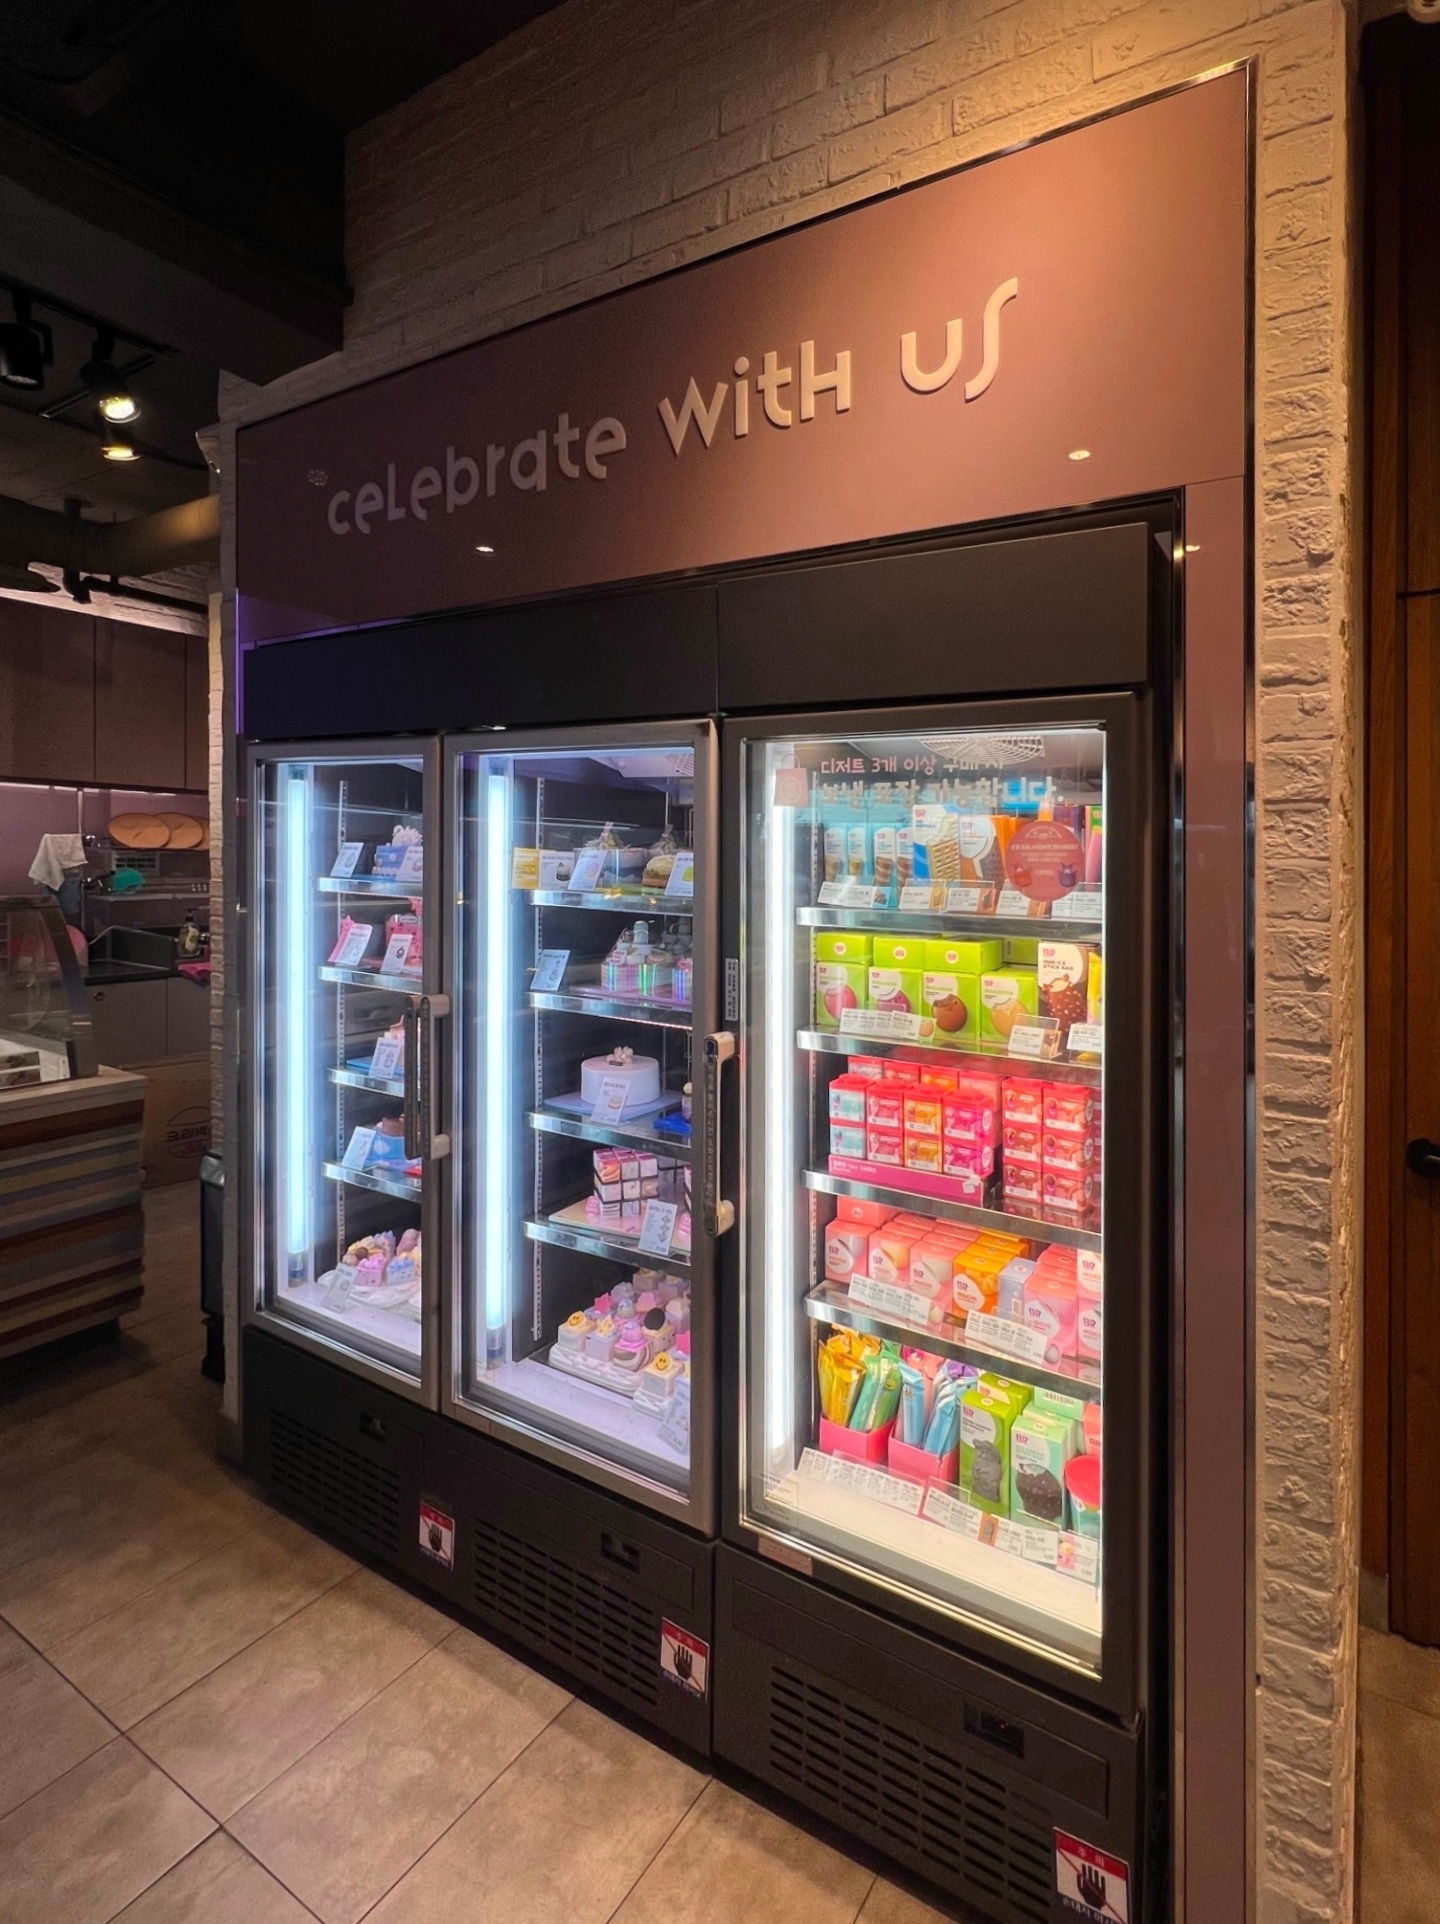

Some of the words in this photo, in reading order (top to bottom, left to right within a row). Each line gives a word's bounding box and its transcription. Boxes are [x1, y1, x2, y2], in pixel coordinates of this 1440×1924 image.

[901, 276, 1018, 403] us
[820, 757, 866, 774] 디저트
[871, 757, 898, 774] 3개
[903, 755, 938, 776] 이상
[874, 778, 920, 808] 포장
[957, 1280, 968, 1292] BR
[1028, 1307, 1042, 1319] BR
